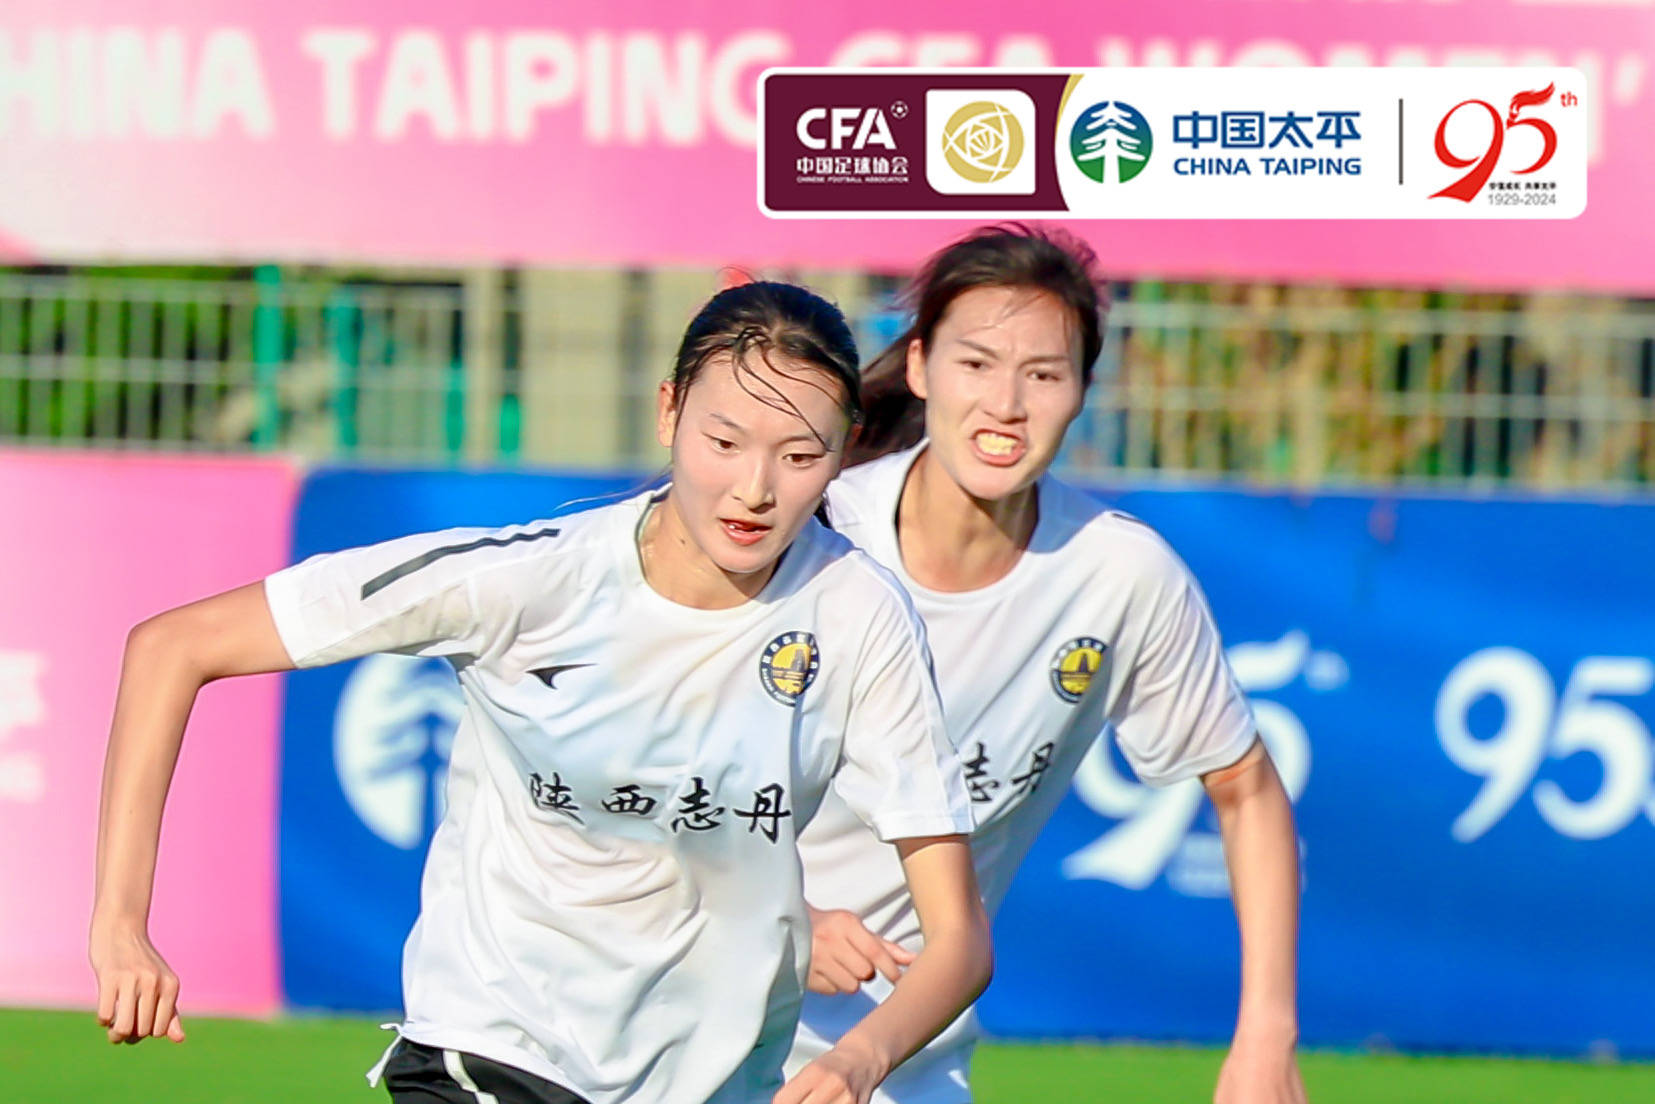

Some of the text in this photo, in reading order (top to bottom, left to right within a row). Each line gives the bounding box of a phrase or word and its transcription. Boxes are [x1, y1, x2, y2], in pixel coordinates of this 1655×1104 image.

[529, 771, 792, 844] 陕西志丹
[1434, 645, 1654, 840] 95
